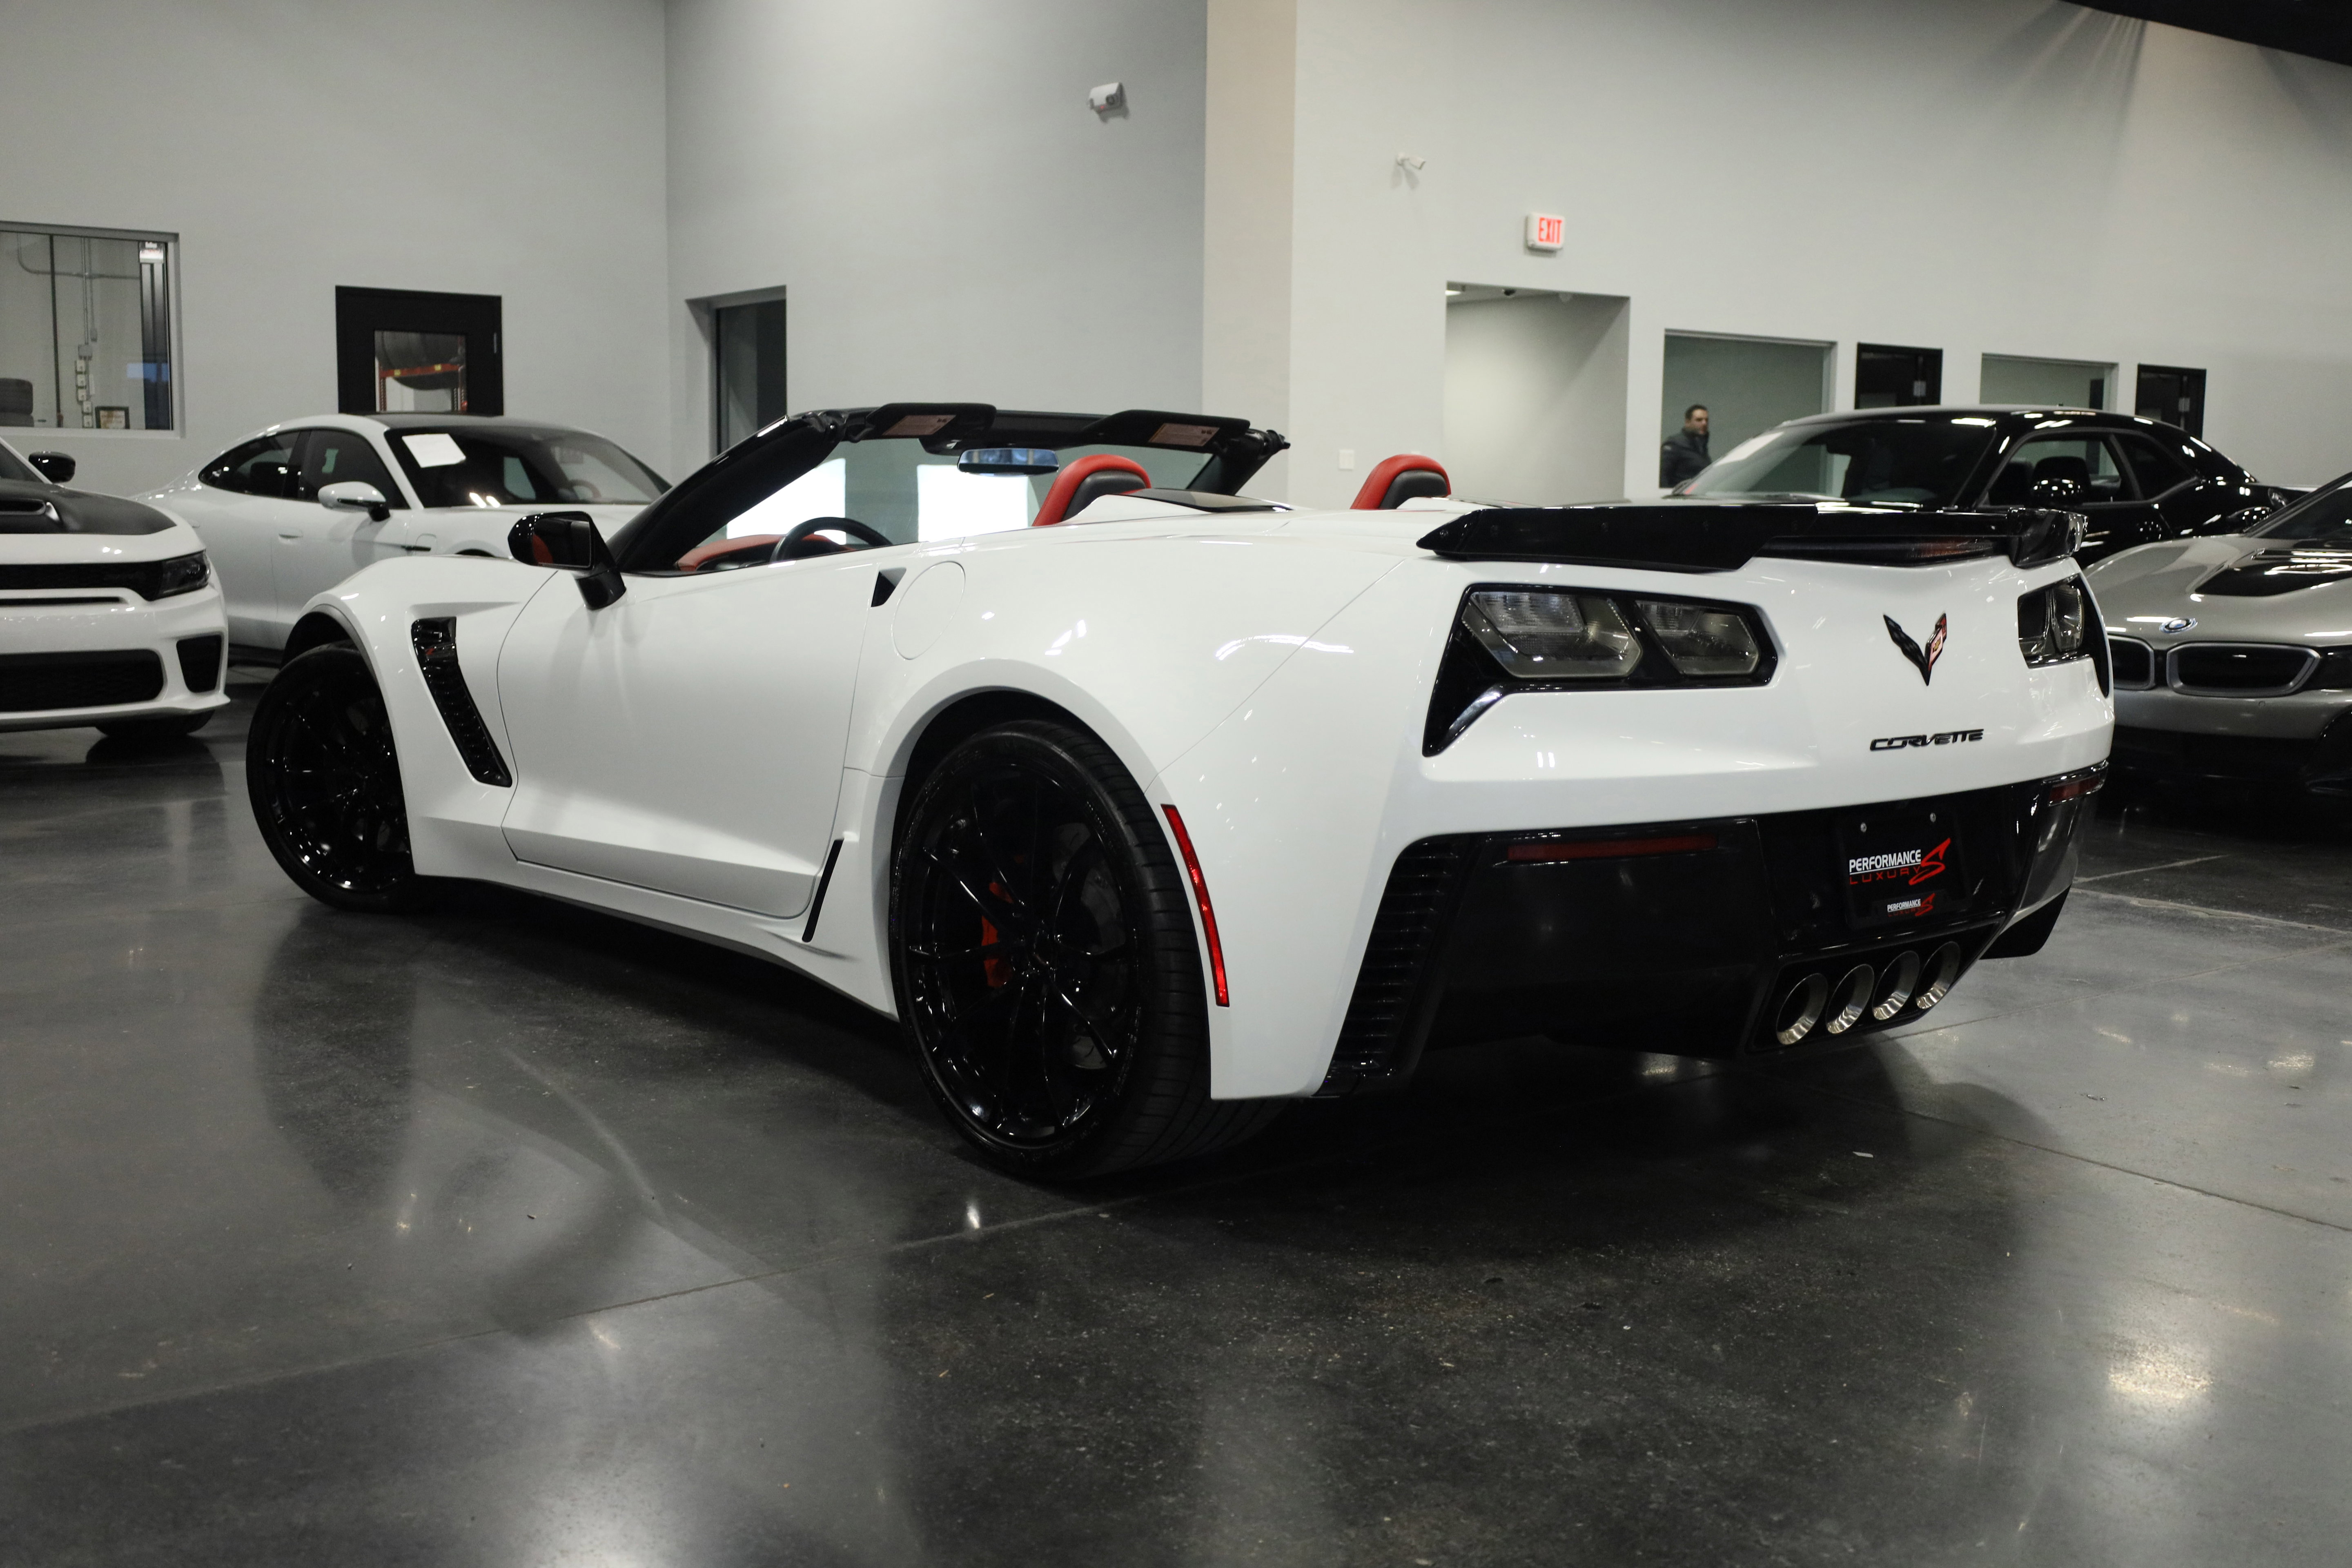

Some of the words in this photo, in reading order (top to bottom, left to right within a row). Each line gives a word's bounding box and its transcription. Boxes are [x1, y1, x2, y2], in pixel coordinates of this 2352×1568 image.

[1538, 217, 1562, 244] EXIT
[1870, 729, 1984, 751] CORVETTE
[1849, 849, 1921, 873] PERFORMANCE
[1849, 866, 1920, 885] LUXURY
[1887, 898, 1921, 911] PERFORMANCE
